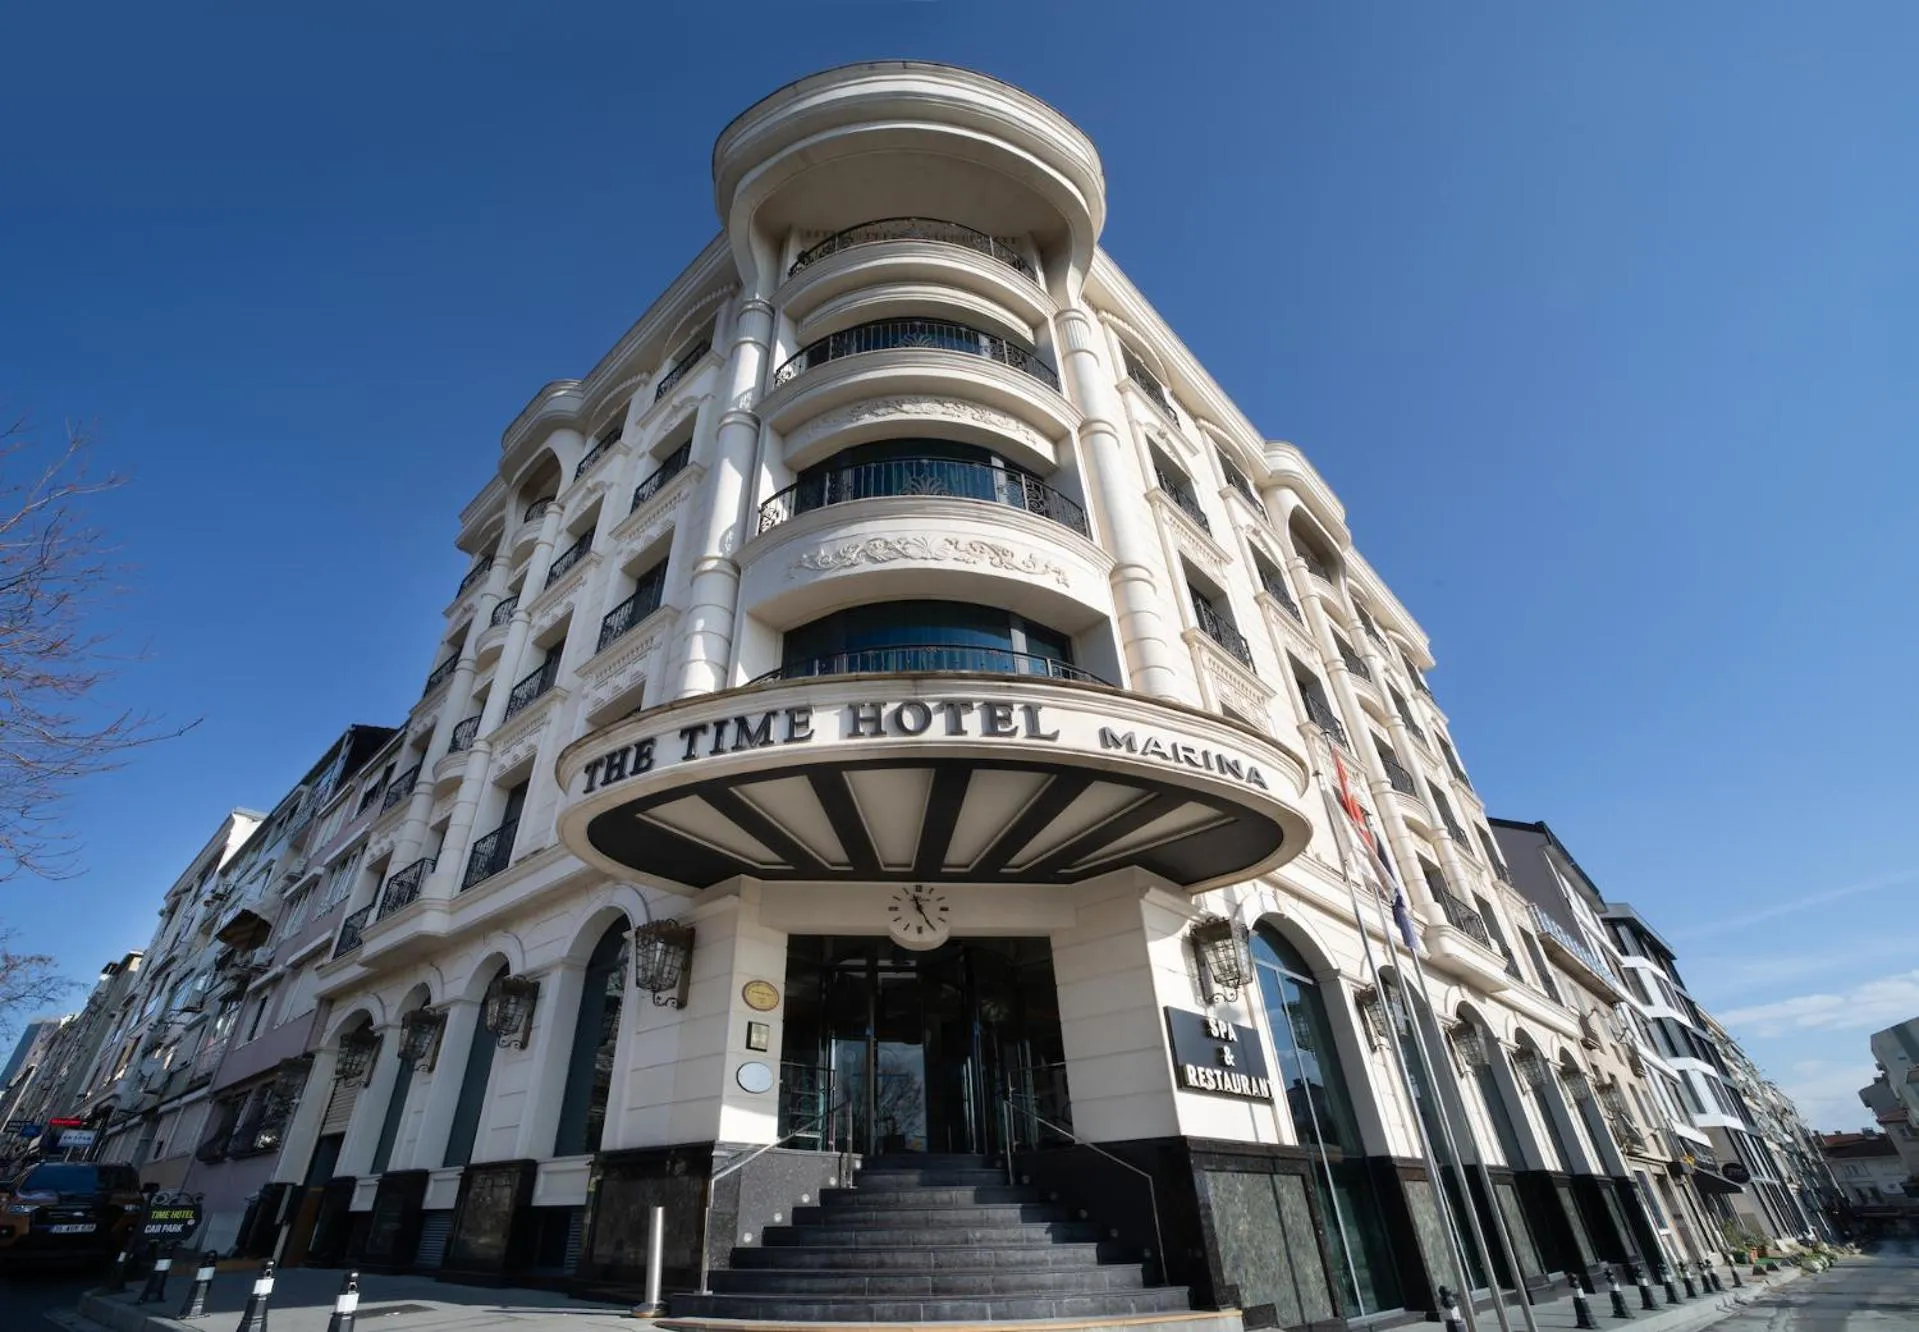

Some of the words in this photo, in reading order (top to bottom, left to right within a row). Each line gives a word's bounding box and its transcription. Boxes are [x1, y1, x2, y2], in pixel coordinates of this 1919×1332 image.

[582, 736, 657, 794] THE
[679, 705, 816, 761] TIME
[846, 700, 1061, 741] HOTEL
[1098, 726, 1270, 790] MARINA
[1207, 1017, 1238, 1041] SPA
[1223, 1045, 1235, 1067] &
[151, 1210, 169, 1219] TIME
[170, 1210, 194, 1219] HOTEL
[144, 1224, 161, 1234] CAR
[161, 1223, 184, 1233] PARK
